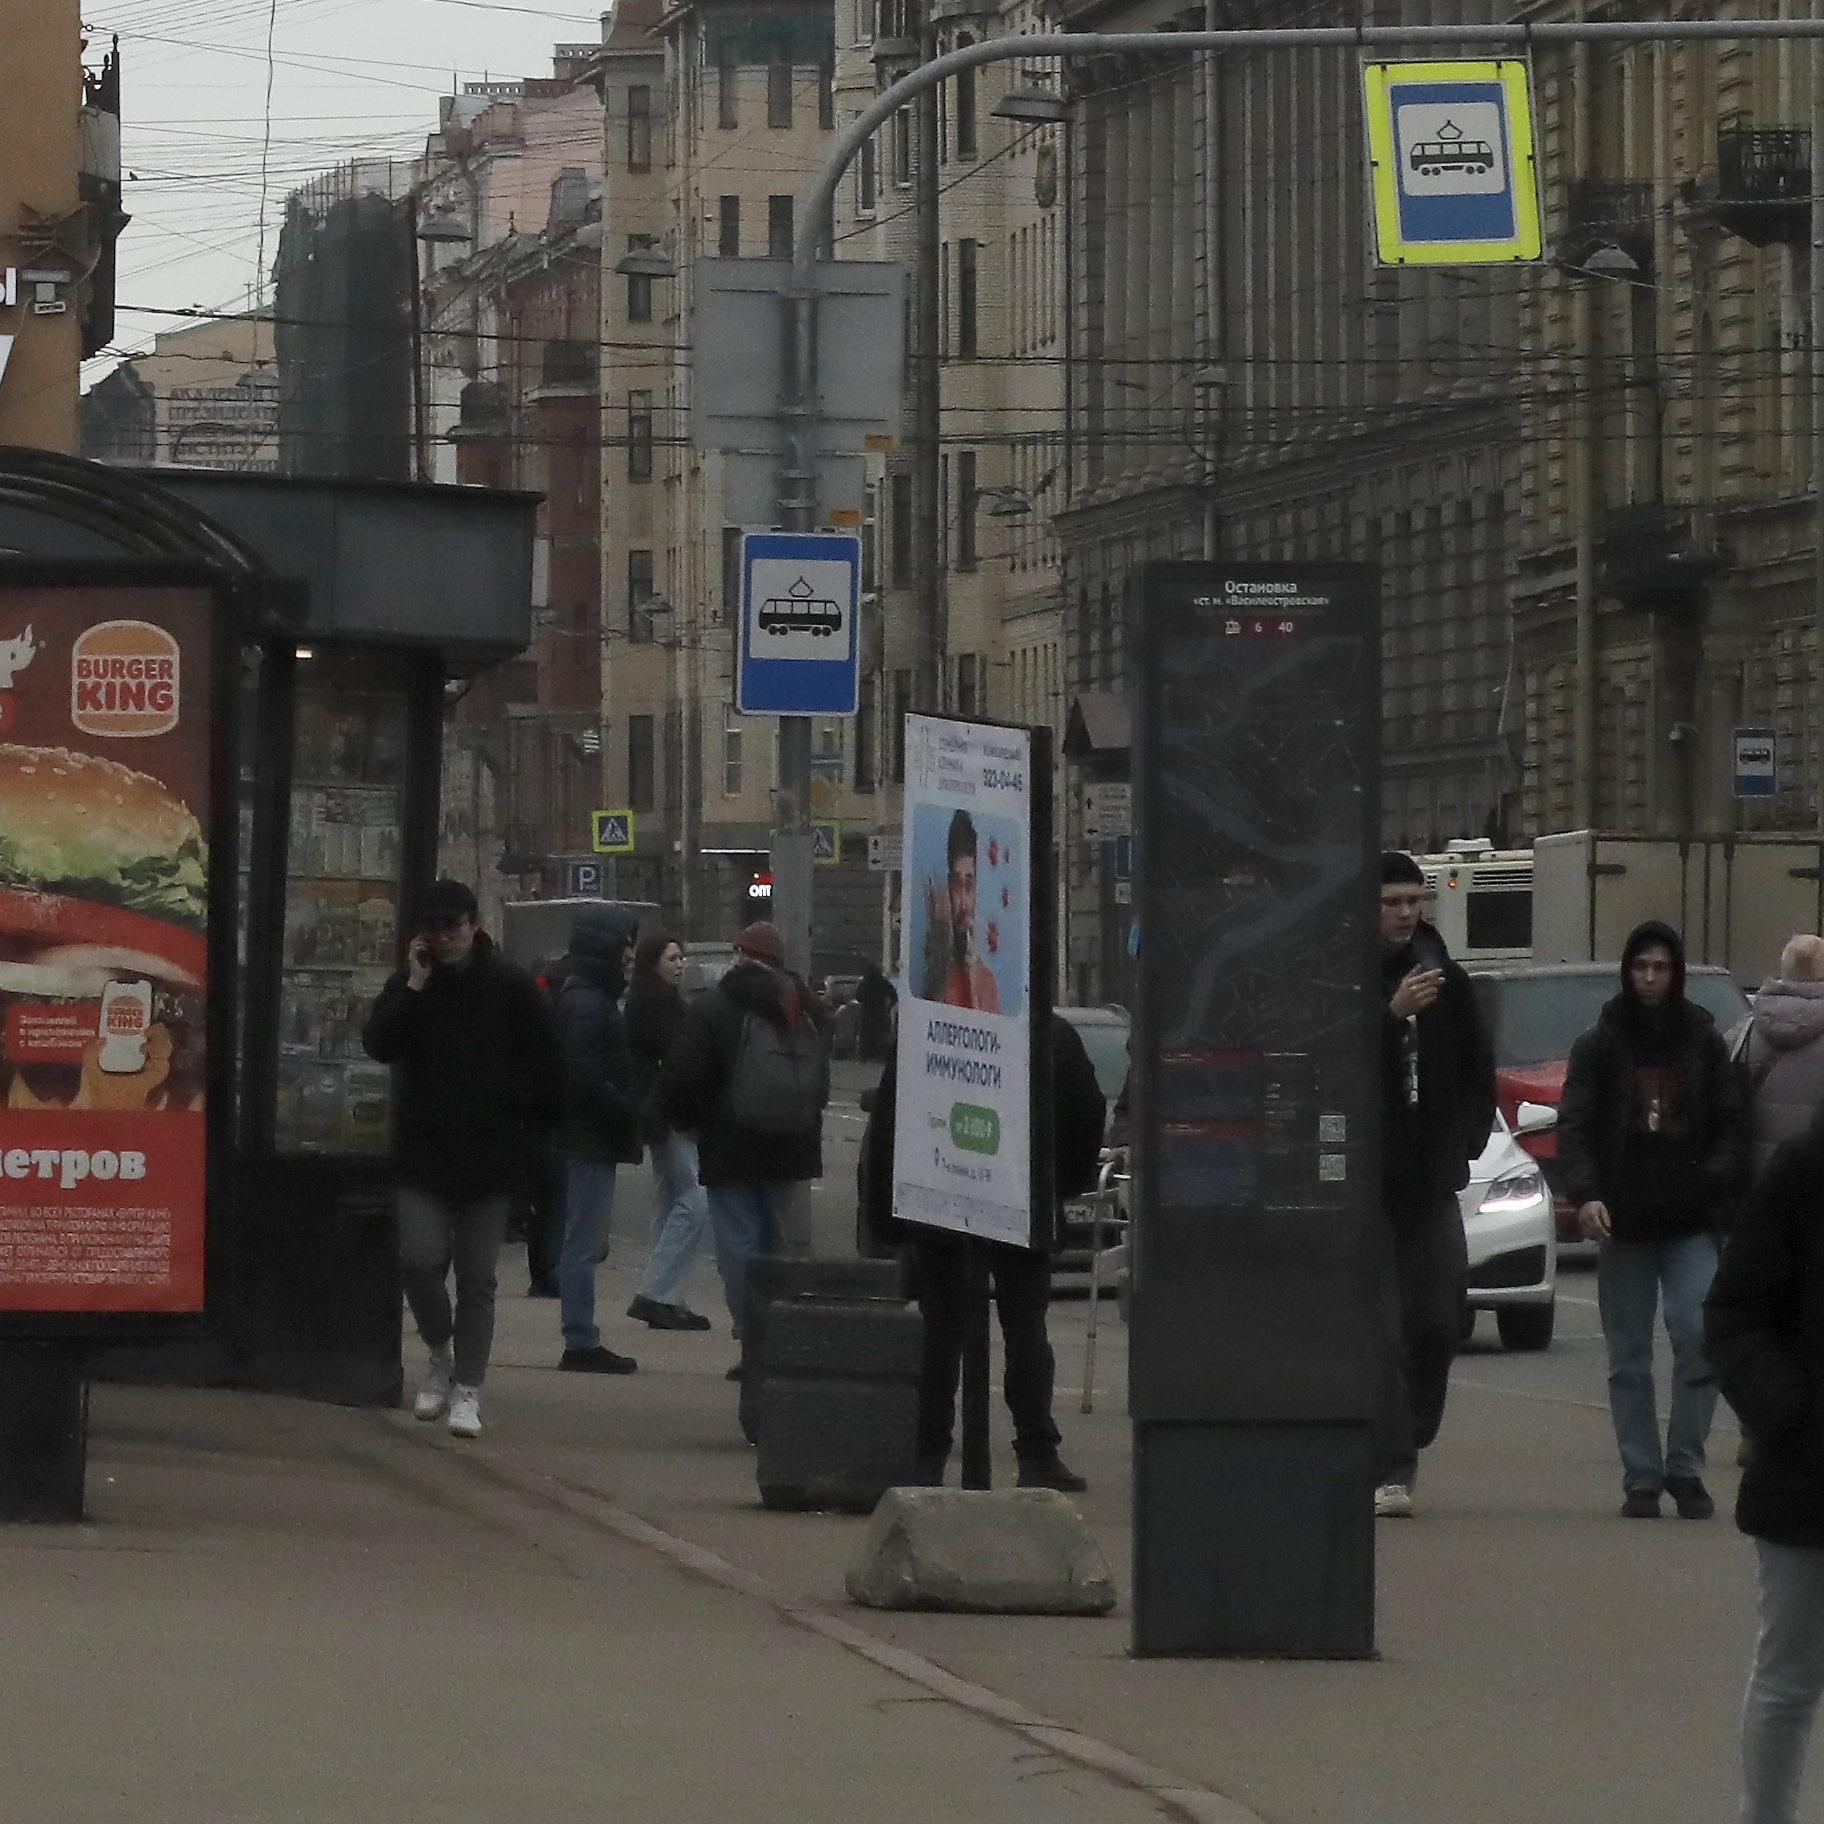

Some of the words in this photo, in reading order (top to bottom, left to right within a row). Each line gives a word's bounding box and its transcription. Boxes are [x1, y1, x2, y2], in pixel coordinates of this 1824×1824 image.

[1224, 580, 1298, 594] Остановка
[1255, 621, 1263, 633] 6
[1278, 621, 1294, 633] 40
[76, 656, 174, 683] BURGER
[76, 679, 174, 714] KING
[926, 1051, 1002, 1089] ИММУНОЛОГИ
